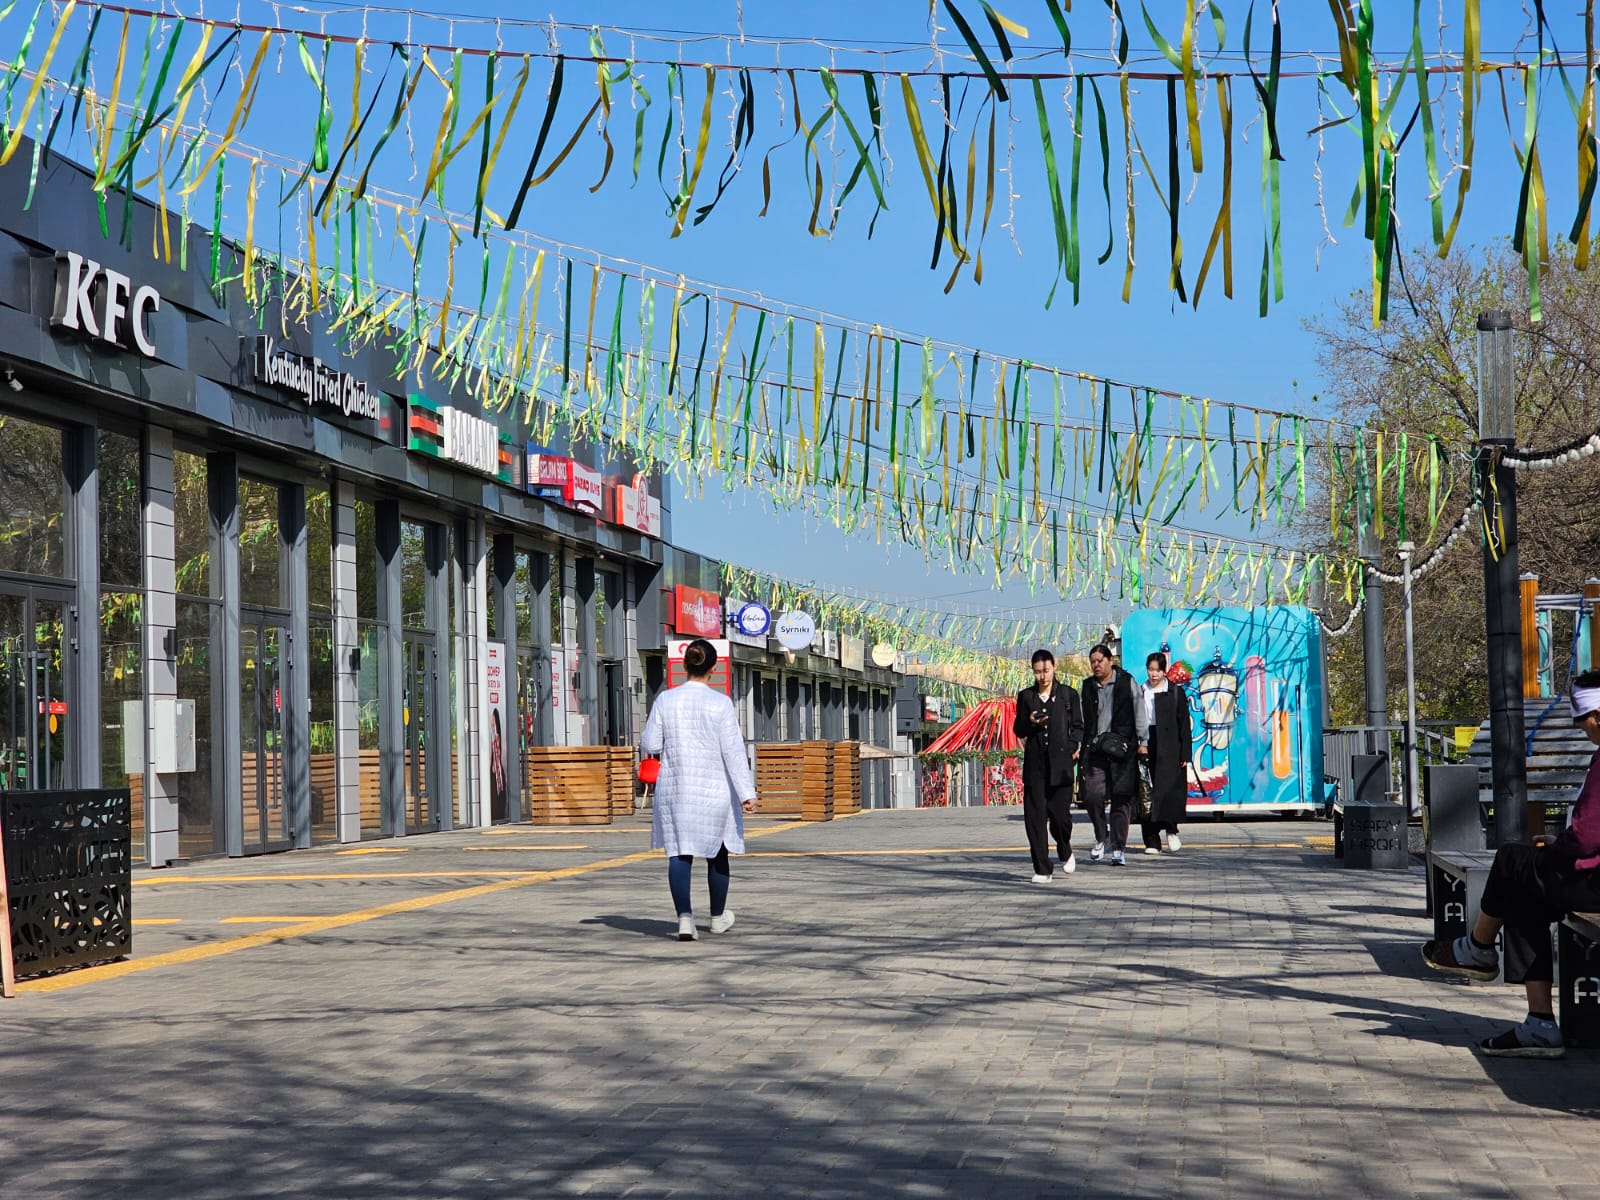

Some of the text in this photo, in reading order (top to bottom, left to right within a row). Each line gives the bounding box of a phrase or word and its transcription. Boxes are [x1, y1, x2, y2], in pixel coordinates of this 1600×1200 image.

[60, 251, 160, 357] KFC
[264, 334, 380, 421] Kentucky Fried Chicken
